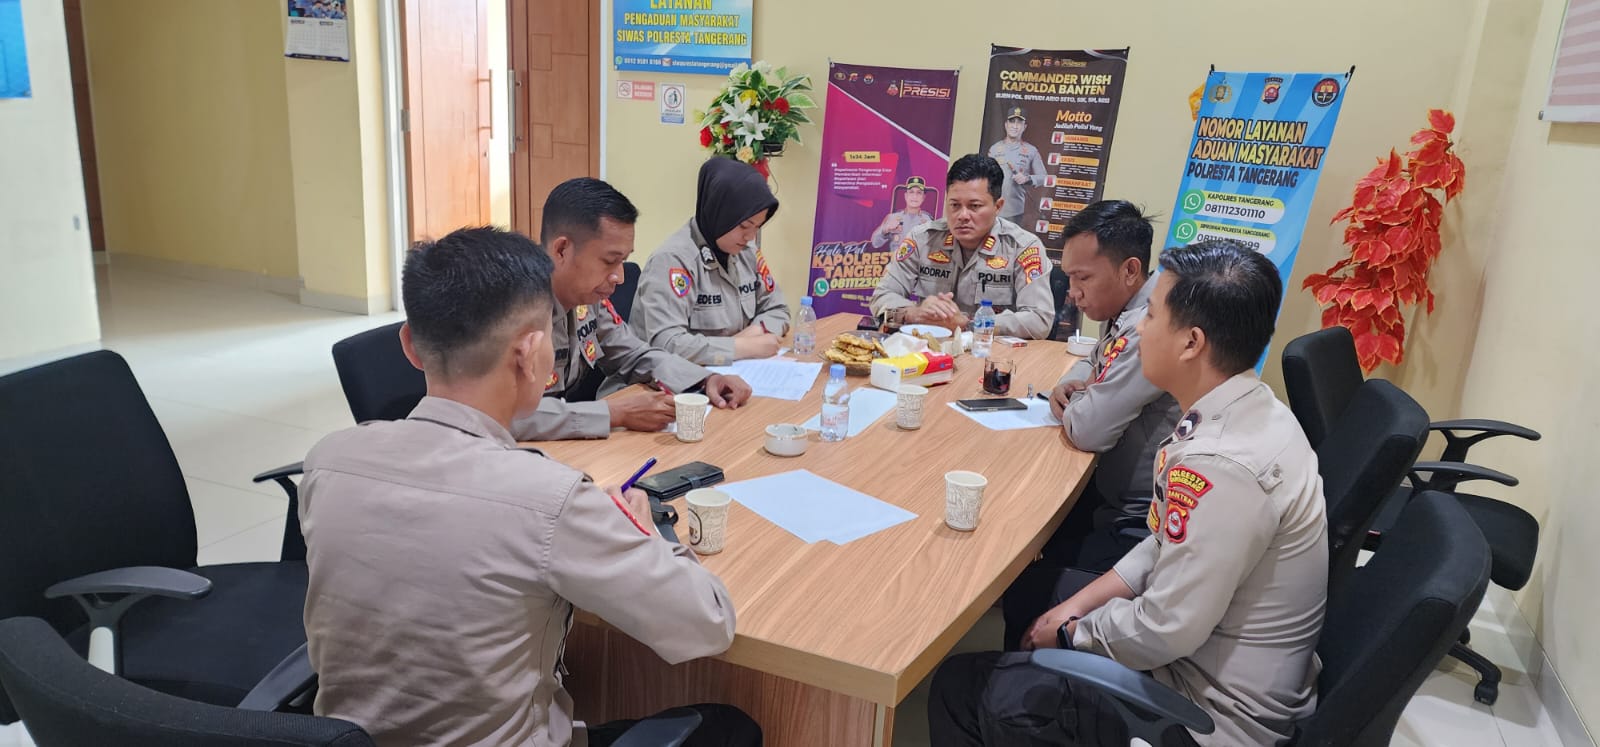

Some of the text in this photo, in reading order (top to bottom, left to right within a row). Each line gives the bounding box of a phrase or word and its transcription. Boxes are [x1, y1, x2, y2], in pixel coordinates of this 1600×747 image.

[624, 12, 740, 28] PENGADUAN MASYARAKAT
[616, 29, 747, 46] SIWAS POLRESTA TANGERANG
[1000, 70, 1112, 85] COMMANDER WISH
[903, 86, 951, 98] PRESISI
[1002, 81, 1106, 96] KAPOLDA BANTEN
[1056, 110, 1092, 123] Motto
[1054, 133, 1062, 143] H
[1198, 117, 1307, 145] NOMOR LAYANAN
[1191, 139, 1324, 169] ADUAN MASYARAKAT
[1187, 162, 1299, 188] POLRESTA TANGERANG
[1041, 199, 1050, 209] A
[1208, 193, 1274, 206] KAPOLRES TANGERANG
[1204, 203, 1266, 219] 081112301110
[1039, 221, 1046, 231] T
[812, 252, 895, 268] KAPOLREST
[824, 265, 888, 279] TANGER
[919, 265, 952, 279] KODRAT
[978, 272, 1011, 283] POLRI
[830, 277, 881, 289] 08111230
